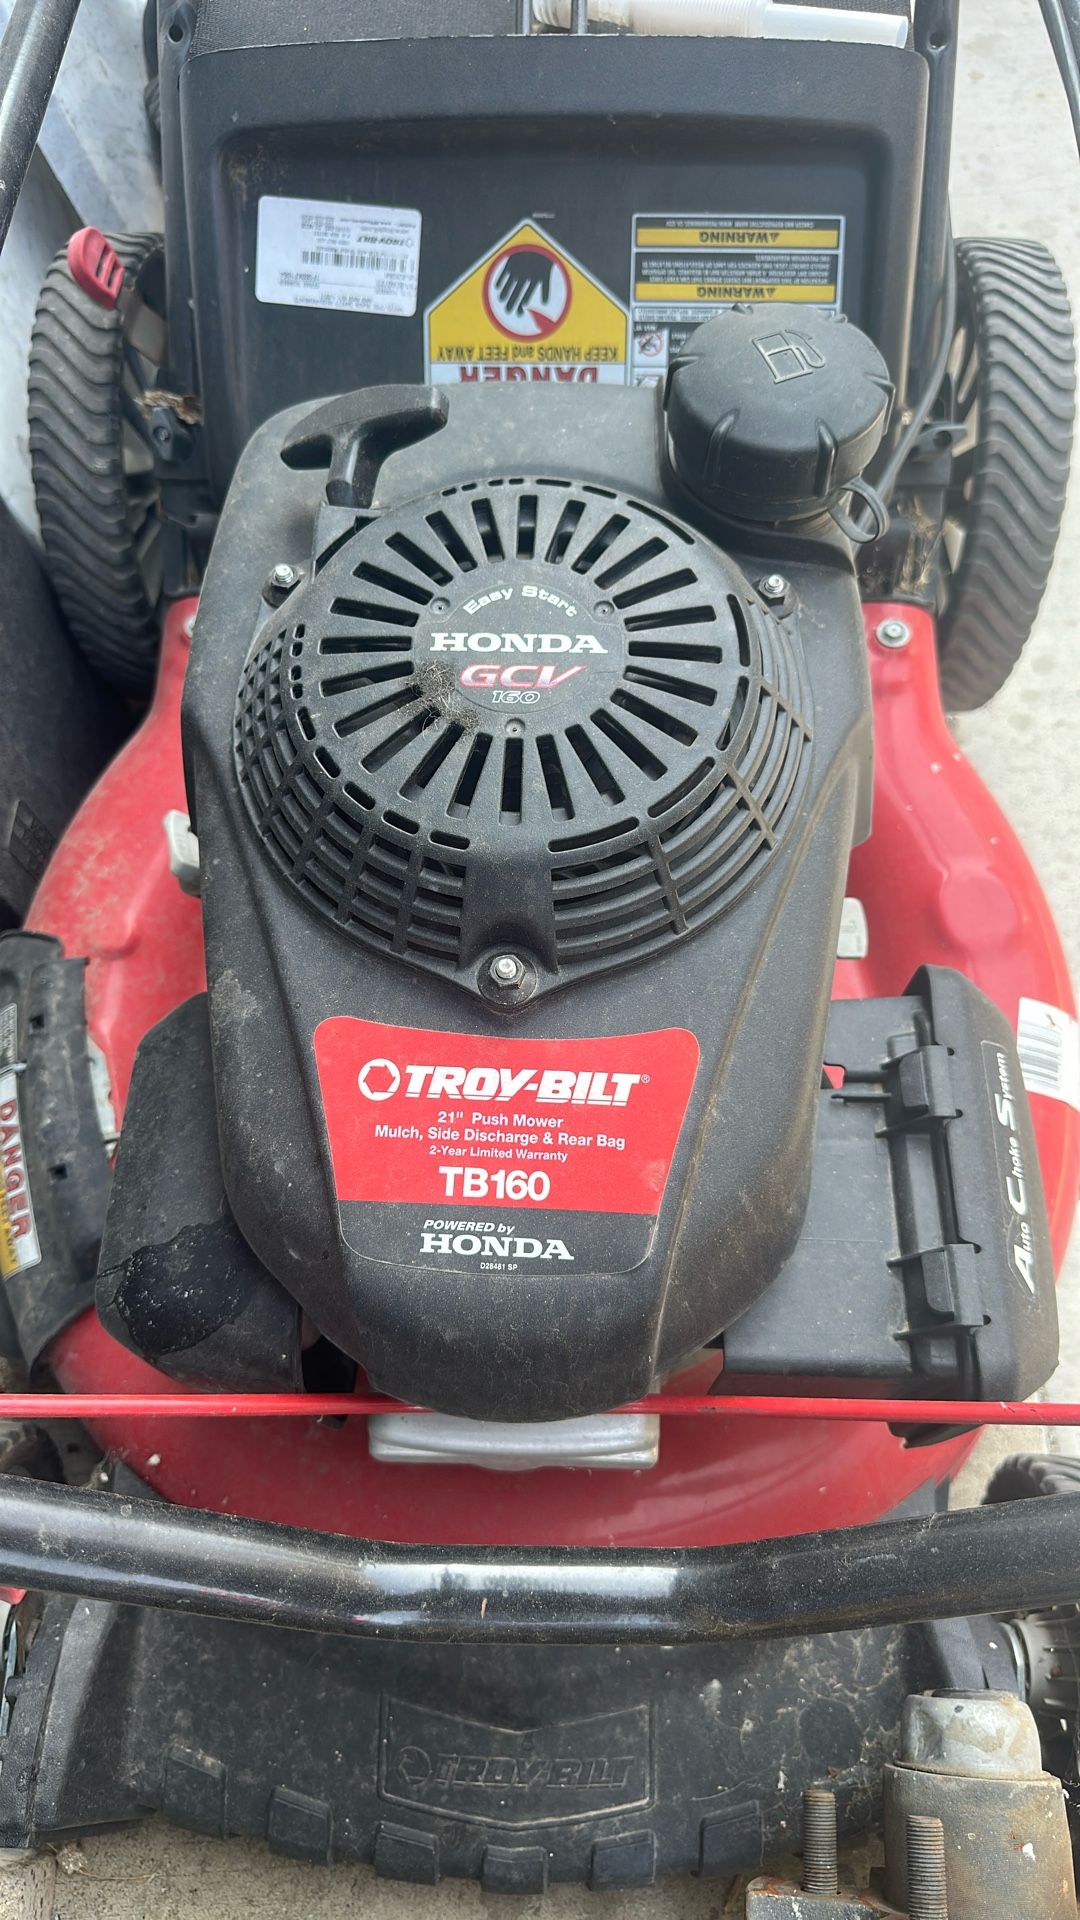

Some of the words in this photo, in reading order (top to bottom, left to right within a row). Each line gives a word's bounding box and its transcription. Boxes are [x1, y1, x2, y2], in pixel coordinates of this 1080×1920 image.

[698, 231, 769, 244] WARNING
[696, 286, 766, 298] WARNING
[437, 345, 475, 362] AWAY
[477, 346, 509, 362] FEET
[511, 345, 534, 359] and
[537, 345, 581, 362] HANDS
[584, 346, 618, 362] KEEP
[463, 587, 514, 615] Easy
[521, 585, 578, 617] Start
[429, 632, 609, 654] HONDA
[459, 664, 588, 689] GCV
[492, 690, 541, 704] 160
[994, 1052, 1018, 1131] System
[437, 1111, 464, 1123] 21"
[471, 1112, 509, 1126] Push
[512, 1114, 565, 1128] Mower
[375, 1125, 424, 1141] Mulch,
[428, 1127, 460, 1141] Side
[464, 1128, 539, 1146] Discharge
[542, 1132, 554, 1144] &
[558, 1133, 593, 1147] Rear
[596, 1135, 626, 1150] Bag
[429, 1145, 467, 1157] 2-Year
[470, 1147, 513, 1160] Limited
[516, 1149, 568, 1163] Warranty
[0, 1100, 32, 1238] DANGER
[1005, 1137, 1028, 1216] Choke
[438, 1165, 551, 1201] TB160
[423, 1219, 495, 1232] POWERED
[497, 1223, 515, 1235] by
[419, 1232, 575, 1261] HONDA
[507, 1263, 518, 1271] SP
[1013, 1221, 1036, 1296] Auto
[436, 1753, 636, 1791] TROY-BILT
